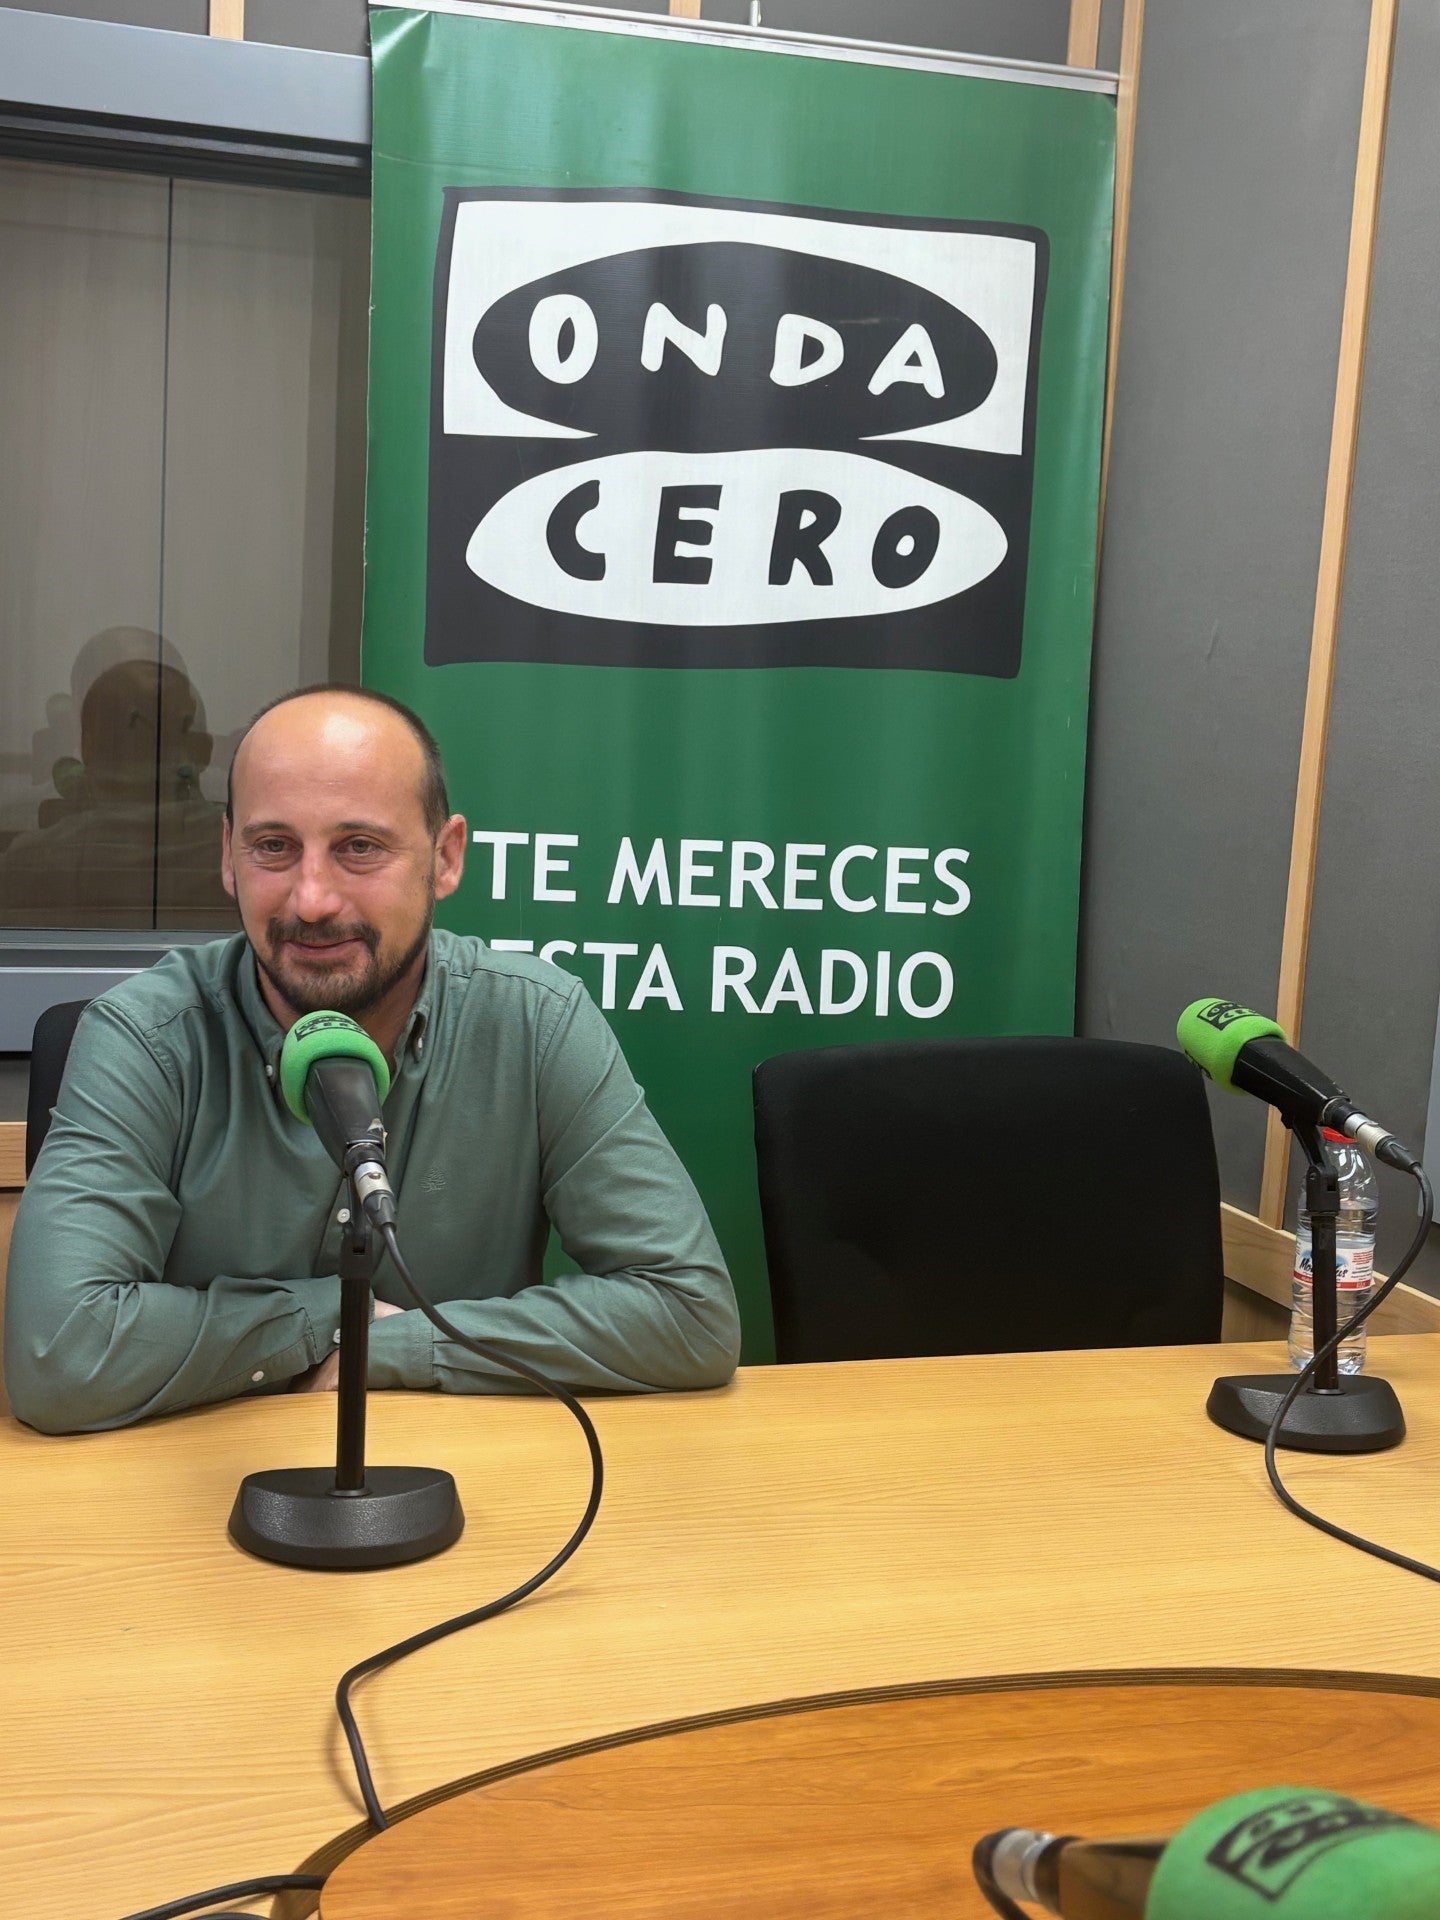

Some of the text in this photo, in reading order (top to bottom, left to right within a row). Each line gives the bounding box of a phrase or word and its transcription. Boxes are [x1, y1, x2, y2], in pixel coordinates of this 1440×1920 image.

[528, 293, 946, 399] ONDA
[545, 479, 940, 589] CERO
[472, 830, 972, 916] TE MERECES
[490, 939, 954, 1019] TA RADIO
